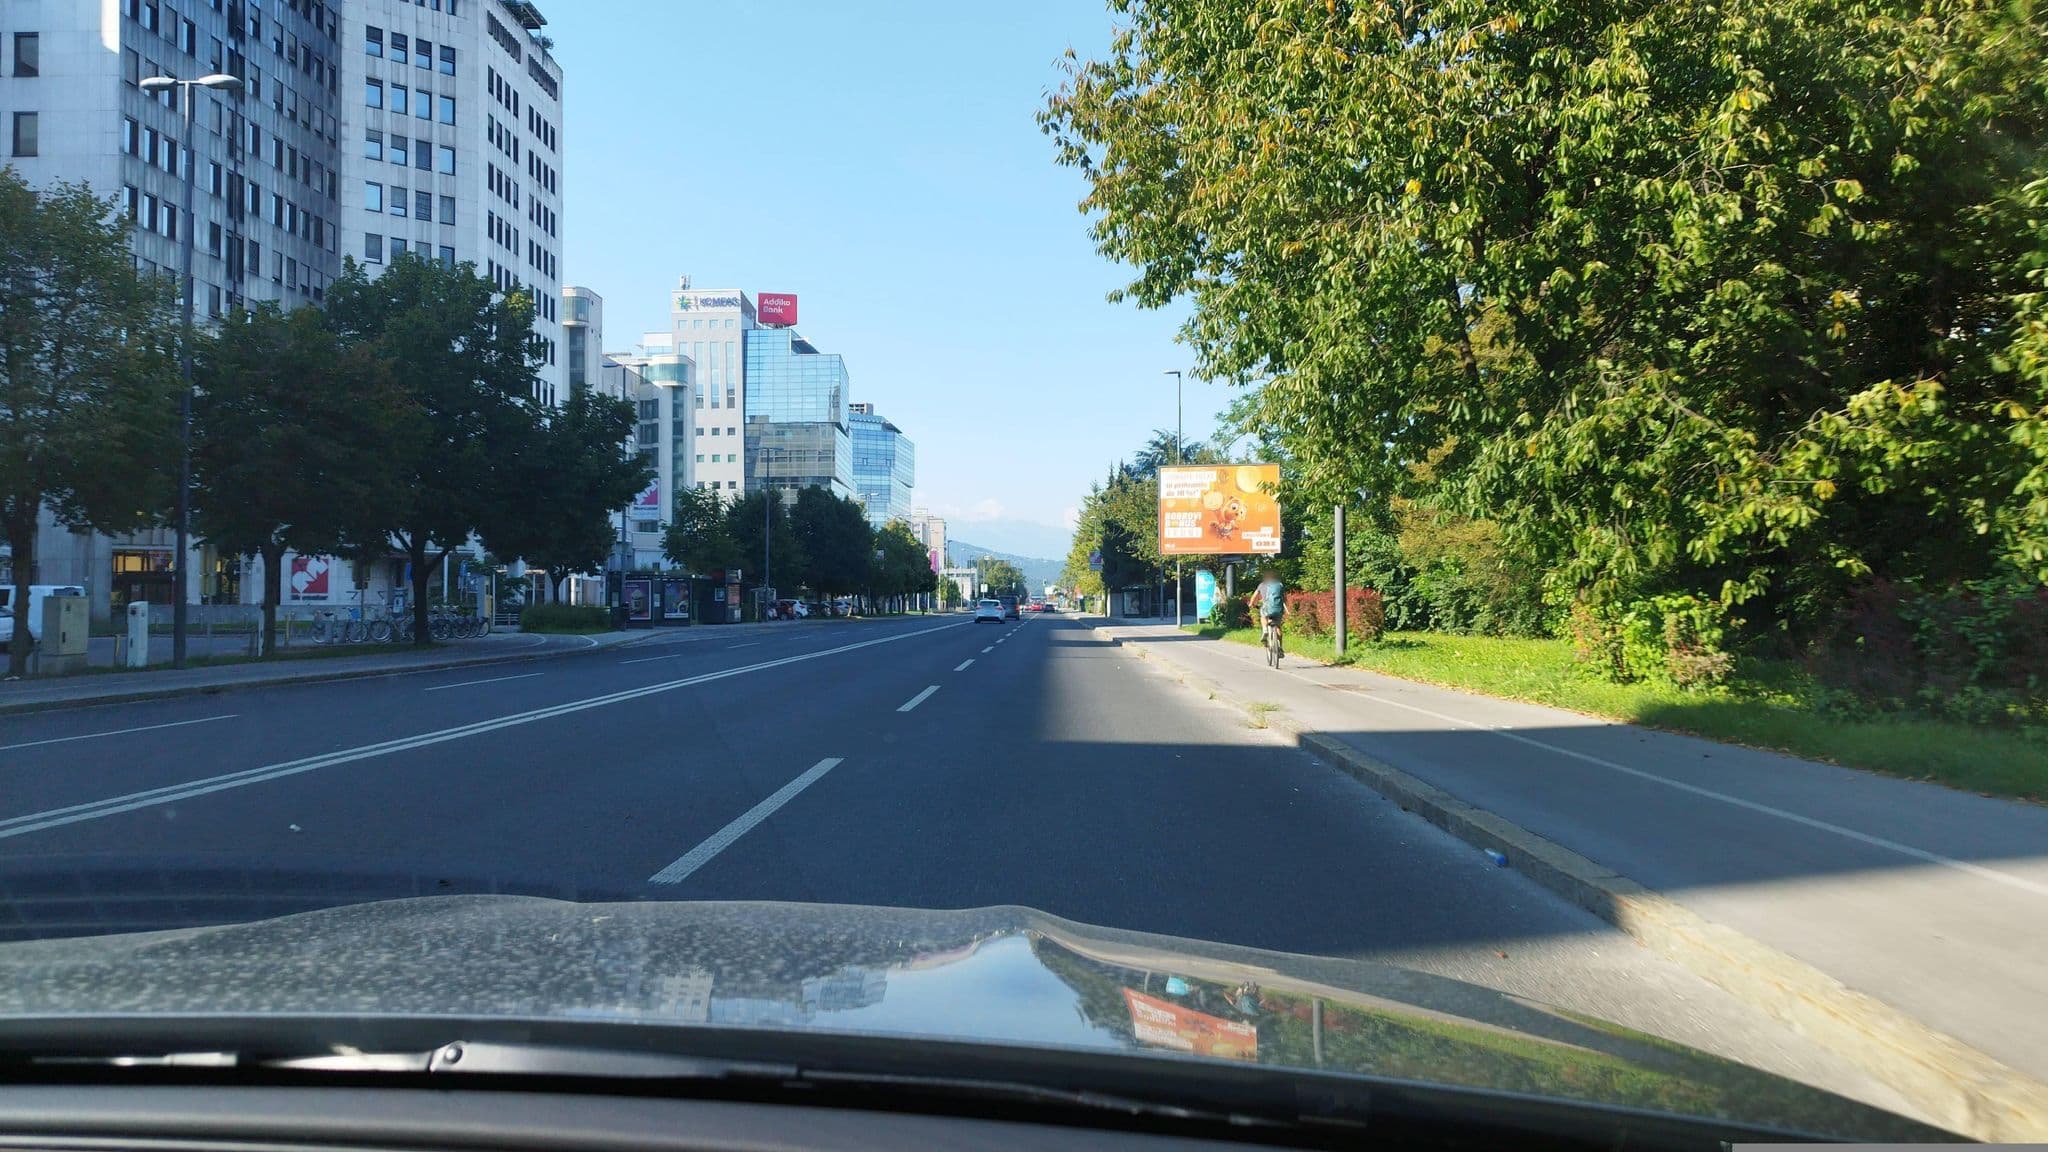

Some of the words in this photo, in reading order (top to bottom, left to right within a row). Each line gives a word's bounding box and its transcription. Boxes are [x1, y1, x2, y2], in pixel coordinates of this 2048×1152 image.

[699, 297, 741, 308] KOMPAS
[763, 298, 791, 306] Addiko
[763, 306, 784, 314] Bank
